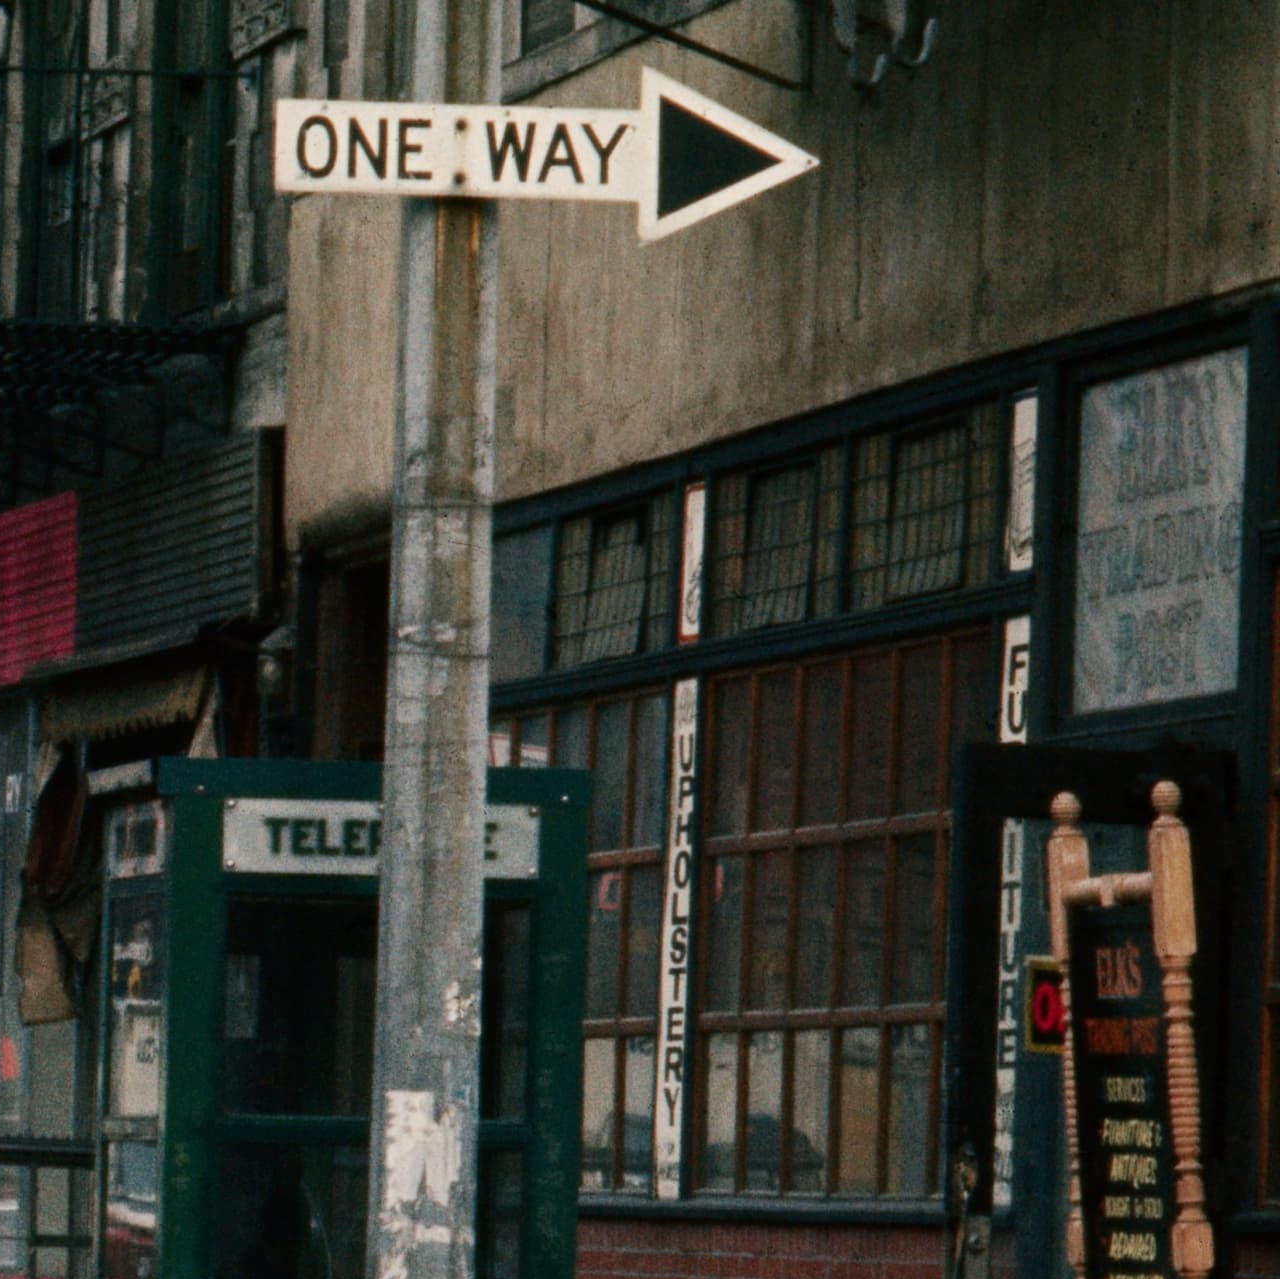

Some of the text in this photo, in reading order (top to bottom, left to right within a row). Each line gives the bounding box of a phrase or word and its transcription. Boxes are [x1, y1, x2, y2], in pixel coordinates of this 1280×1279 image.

[295, 115, 628, 184] ONE WAY
[664, 734, 695, 1128] UPHOLSTERY
[997, 642, 1030, 1069] FUITURE
